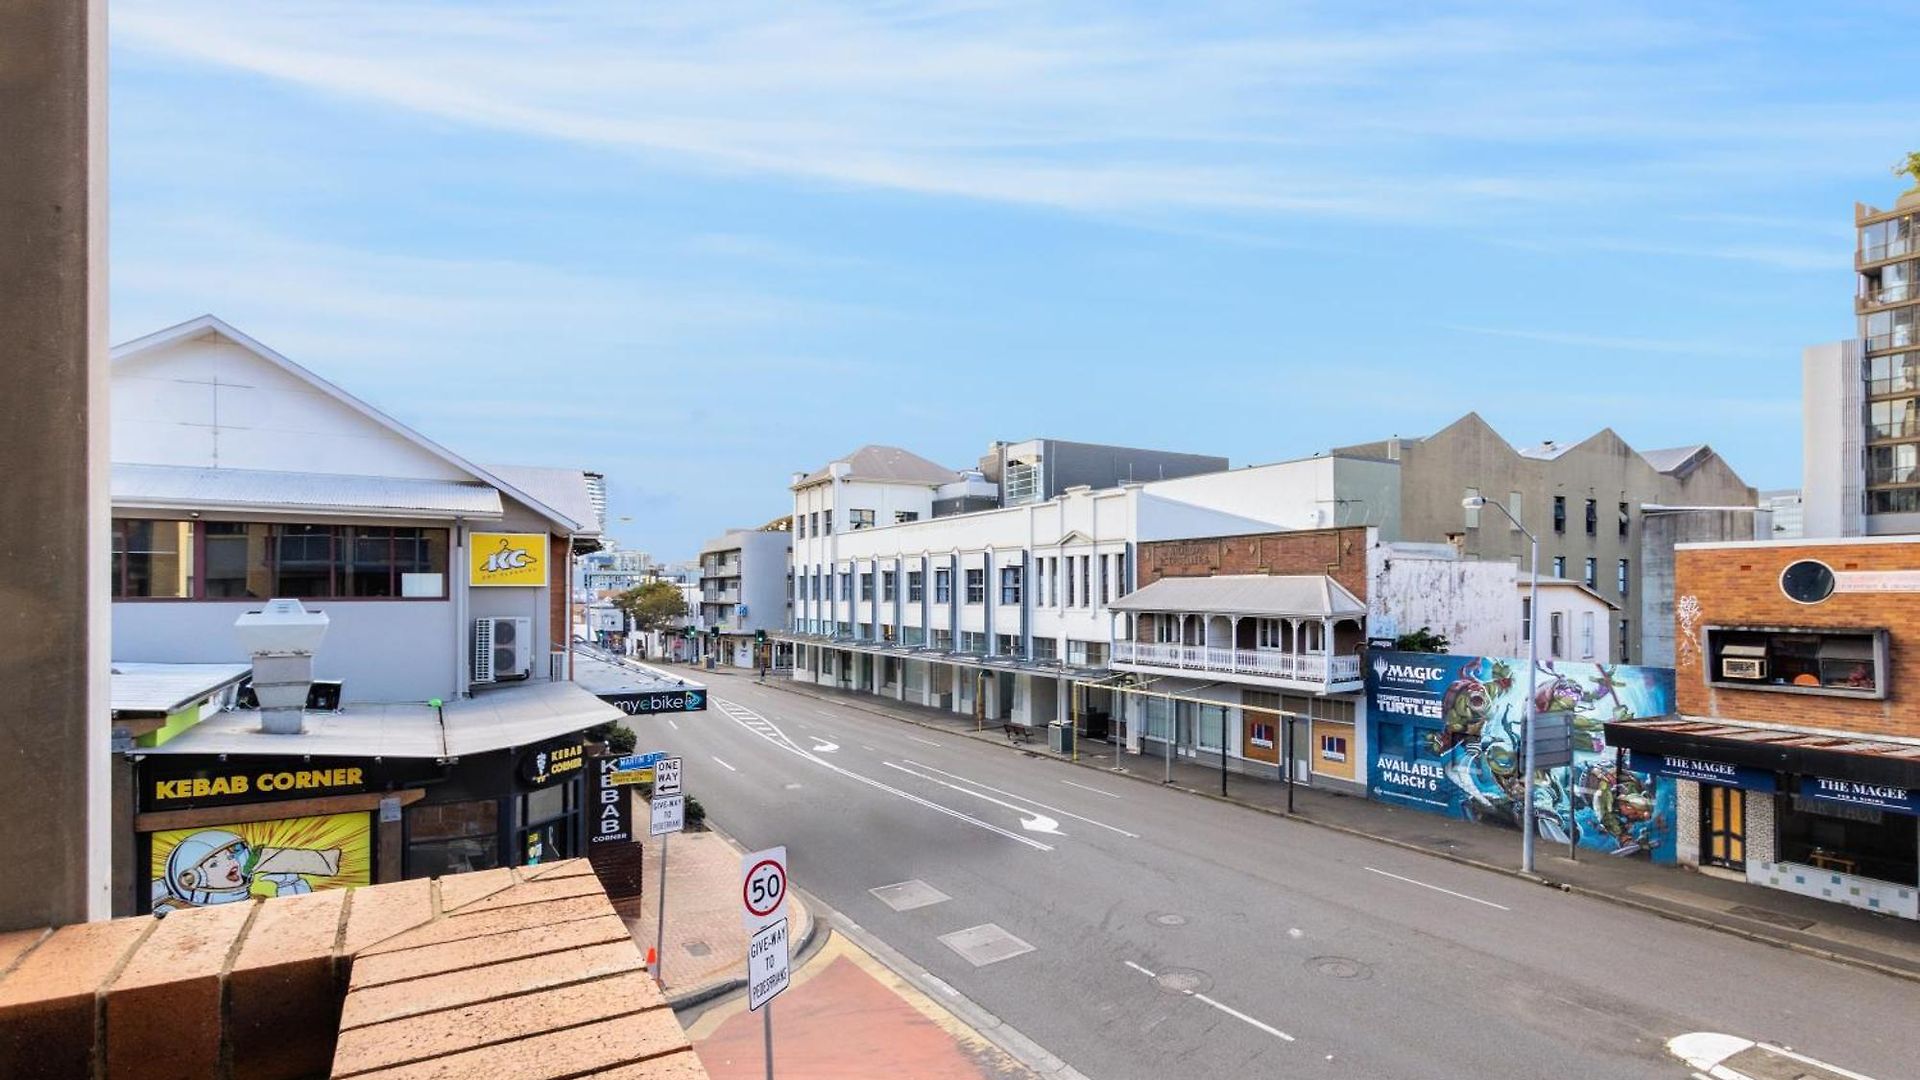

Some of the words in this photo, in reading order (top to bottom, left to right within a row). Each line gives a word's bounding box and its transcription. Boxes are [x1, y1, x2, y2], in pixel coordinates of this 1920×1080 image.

[488, 549, 527, 572] KC
[1387, 665, 1443, 681] MAGIC
[613, 695, 684, 714] myebike
[1377, 700, 1443, 719] TURTLES
[551, 745, 582, 761] KEBAB
[658, 761, 678, 771] ONE
[1377, 757, 1444, 779] AVAILABLE
[1664, 757, 1690, 769] THE
[1691, 761, 1736, 775] MAGEE
[156, 776, 249, 799] KEBAB
[256, 767, 363, 791] CORNER
[658, 773, 678, 782] WAY
[1383, 771, 1426, 789] MARCH
[1429, 780, 1437, 791] 6
[1818, 779, 1849, 793] THE
[1851, 783, 1908, 800] MAGEE
[592, 833, 627, 843] CORNER
[753, 874, 780, 904] 50
